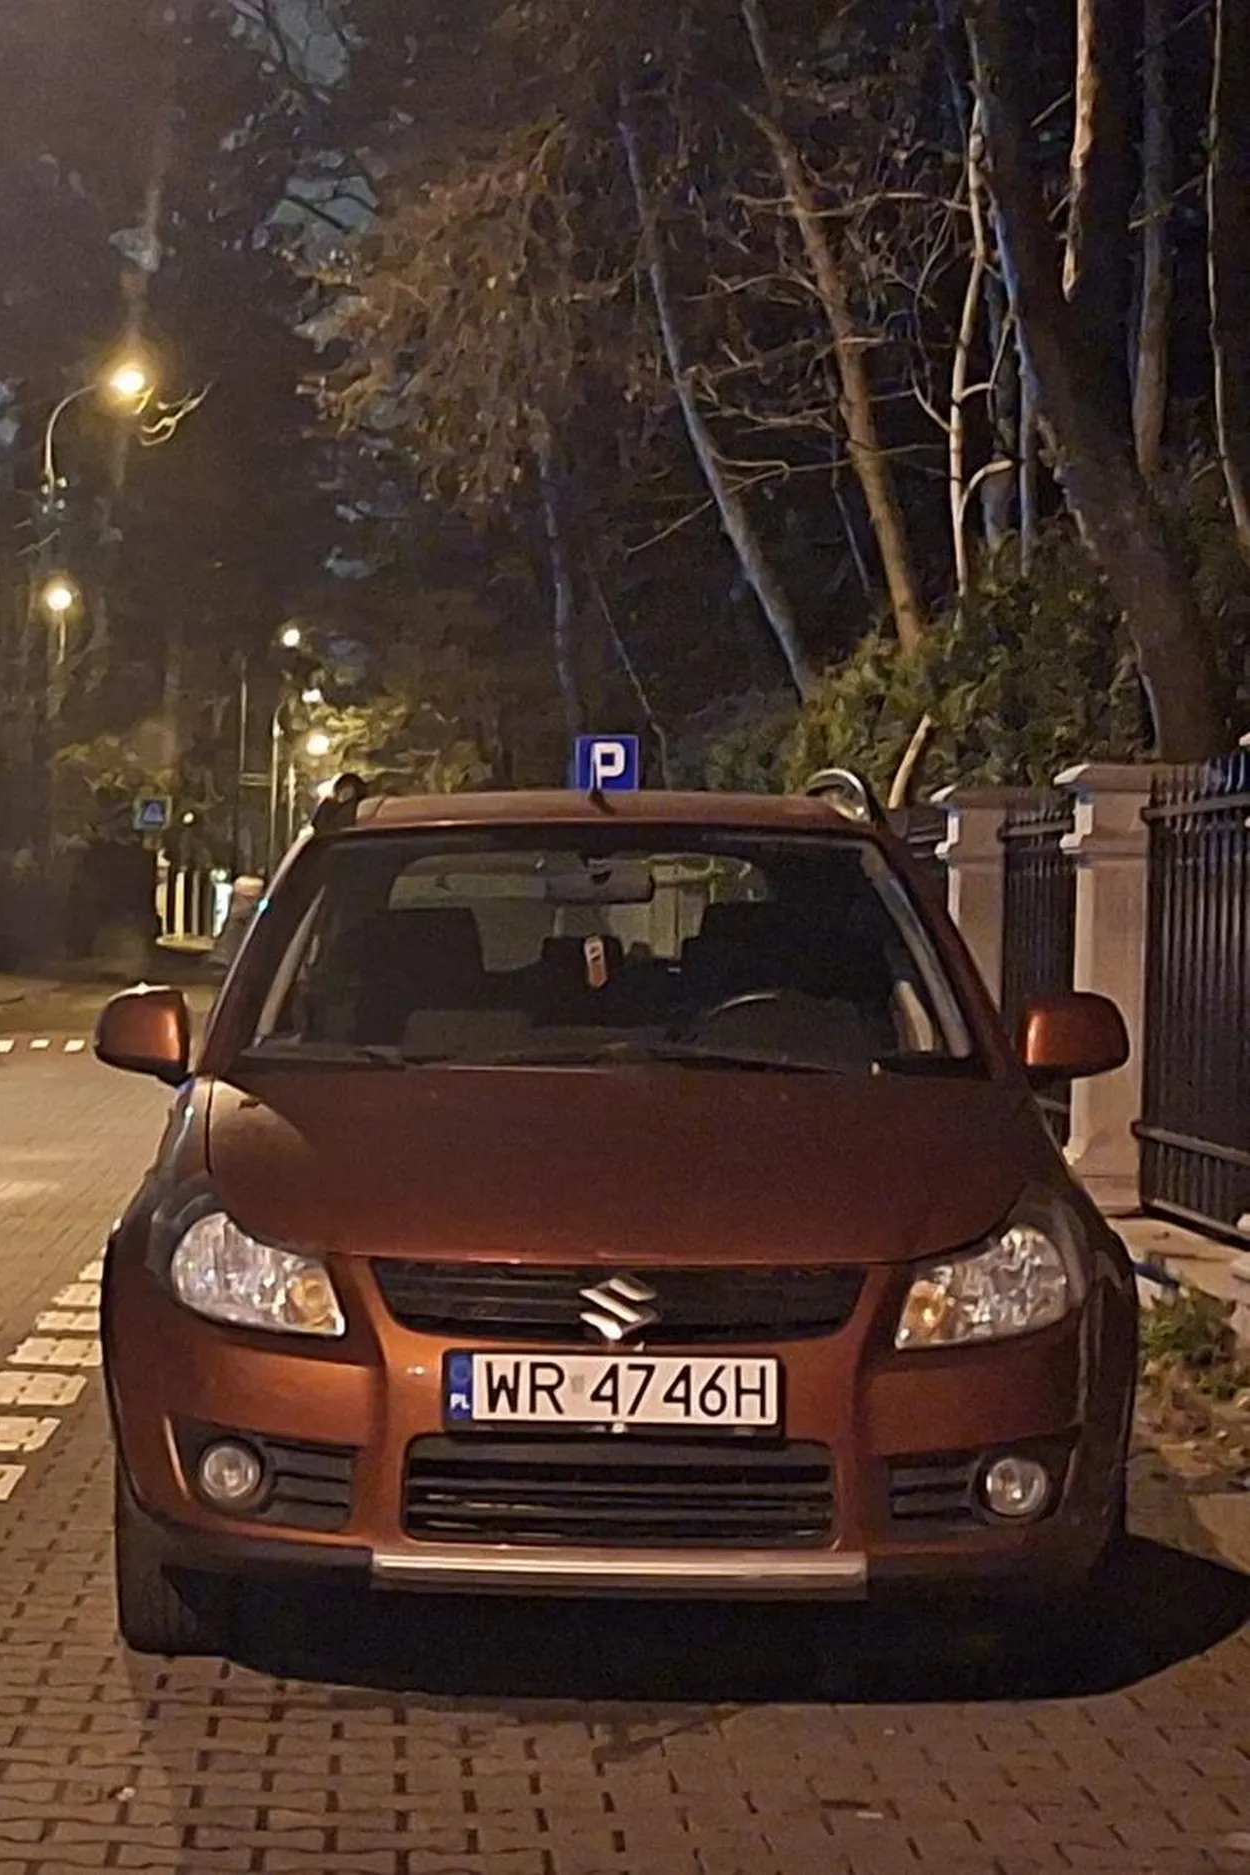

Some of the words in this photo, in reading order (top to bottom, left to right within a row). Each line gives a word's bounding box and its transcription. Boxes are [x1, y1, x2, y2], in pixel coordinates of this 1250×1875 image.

[591, 742, 625, 789] P
[450, 1392, 470, 1410] PL
[486, 1361, 565, 1414] WR
[590, 1363, 766, 1418] 4746H
